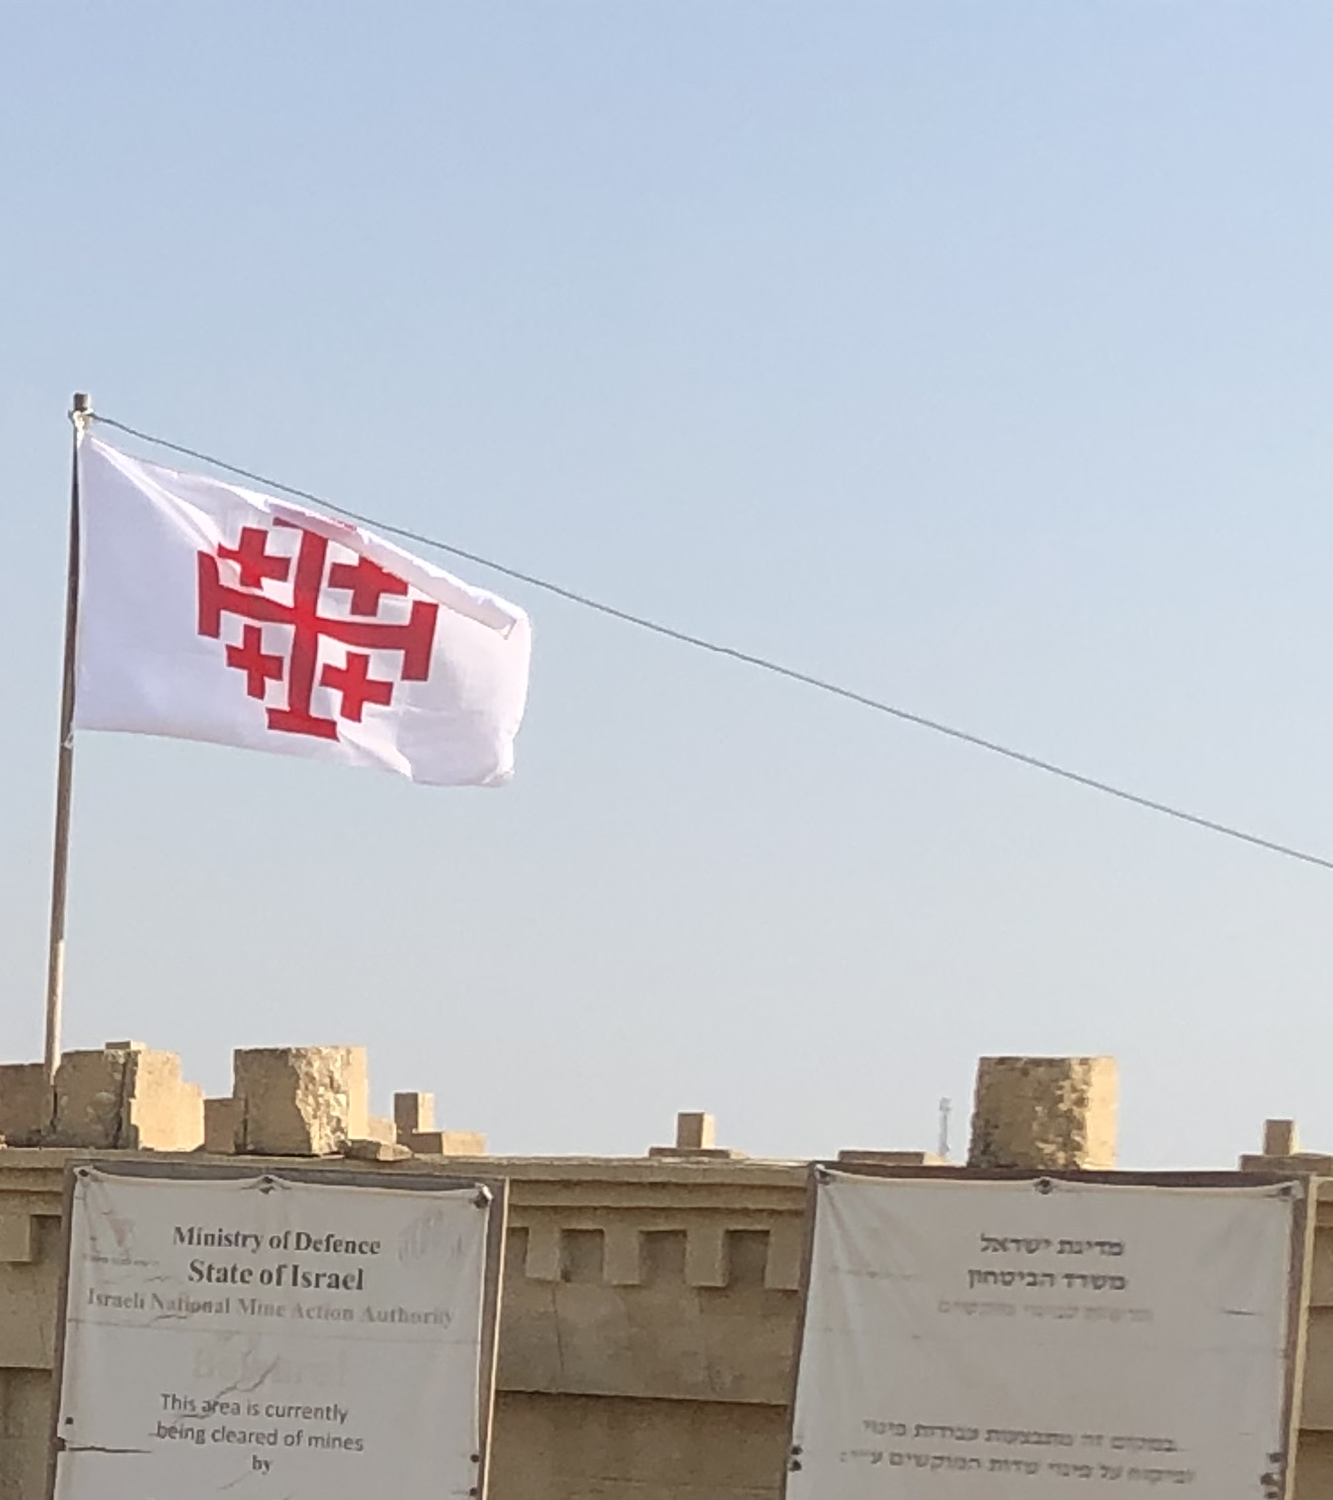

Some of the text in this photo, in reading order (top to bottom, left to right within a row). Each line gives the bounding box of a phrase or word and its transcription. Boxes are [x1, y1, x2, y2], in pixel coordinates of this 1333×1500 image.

[173, 1226, 381, 1254] Ministry of Defence
[981, 1234, 1124, 1256] מדינת ישראל
[188, 1258, 254, 1286] State
[259, 1263, 288, 1286] of
[291, 1264, 364, 1290] Israel
[968, 1269, 1127, 1290] משרד הביטחון
[87, 1288, 454, 1329] Israeli National Mine Action Authority
[161, 1393, 348, 1424] This area is currently
[157, 1421, 364, 1451] being cleared of mines
[252, 1455, 273, 1475] by
[889, 1451, 981, 1471] המוקשים
